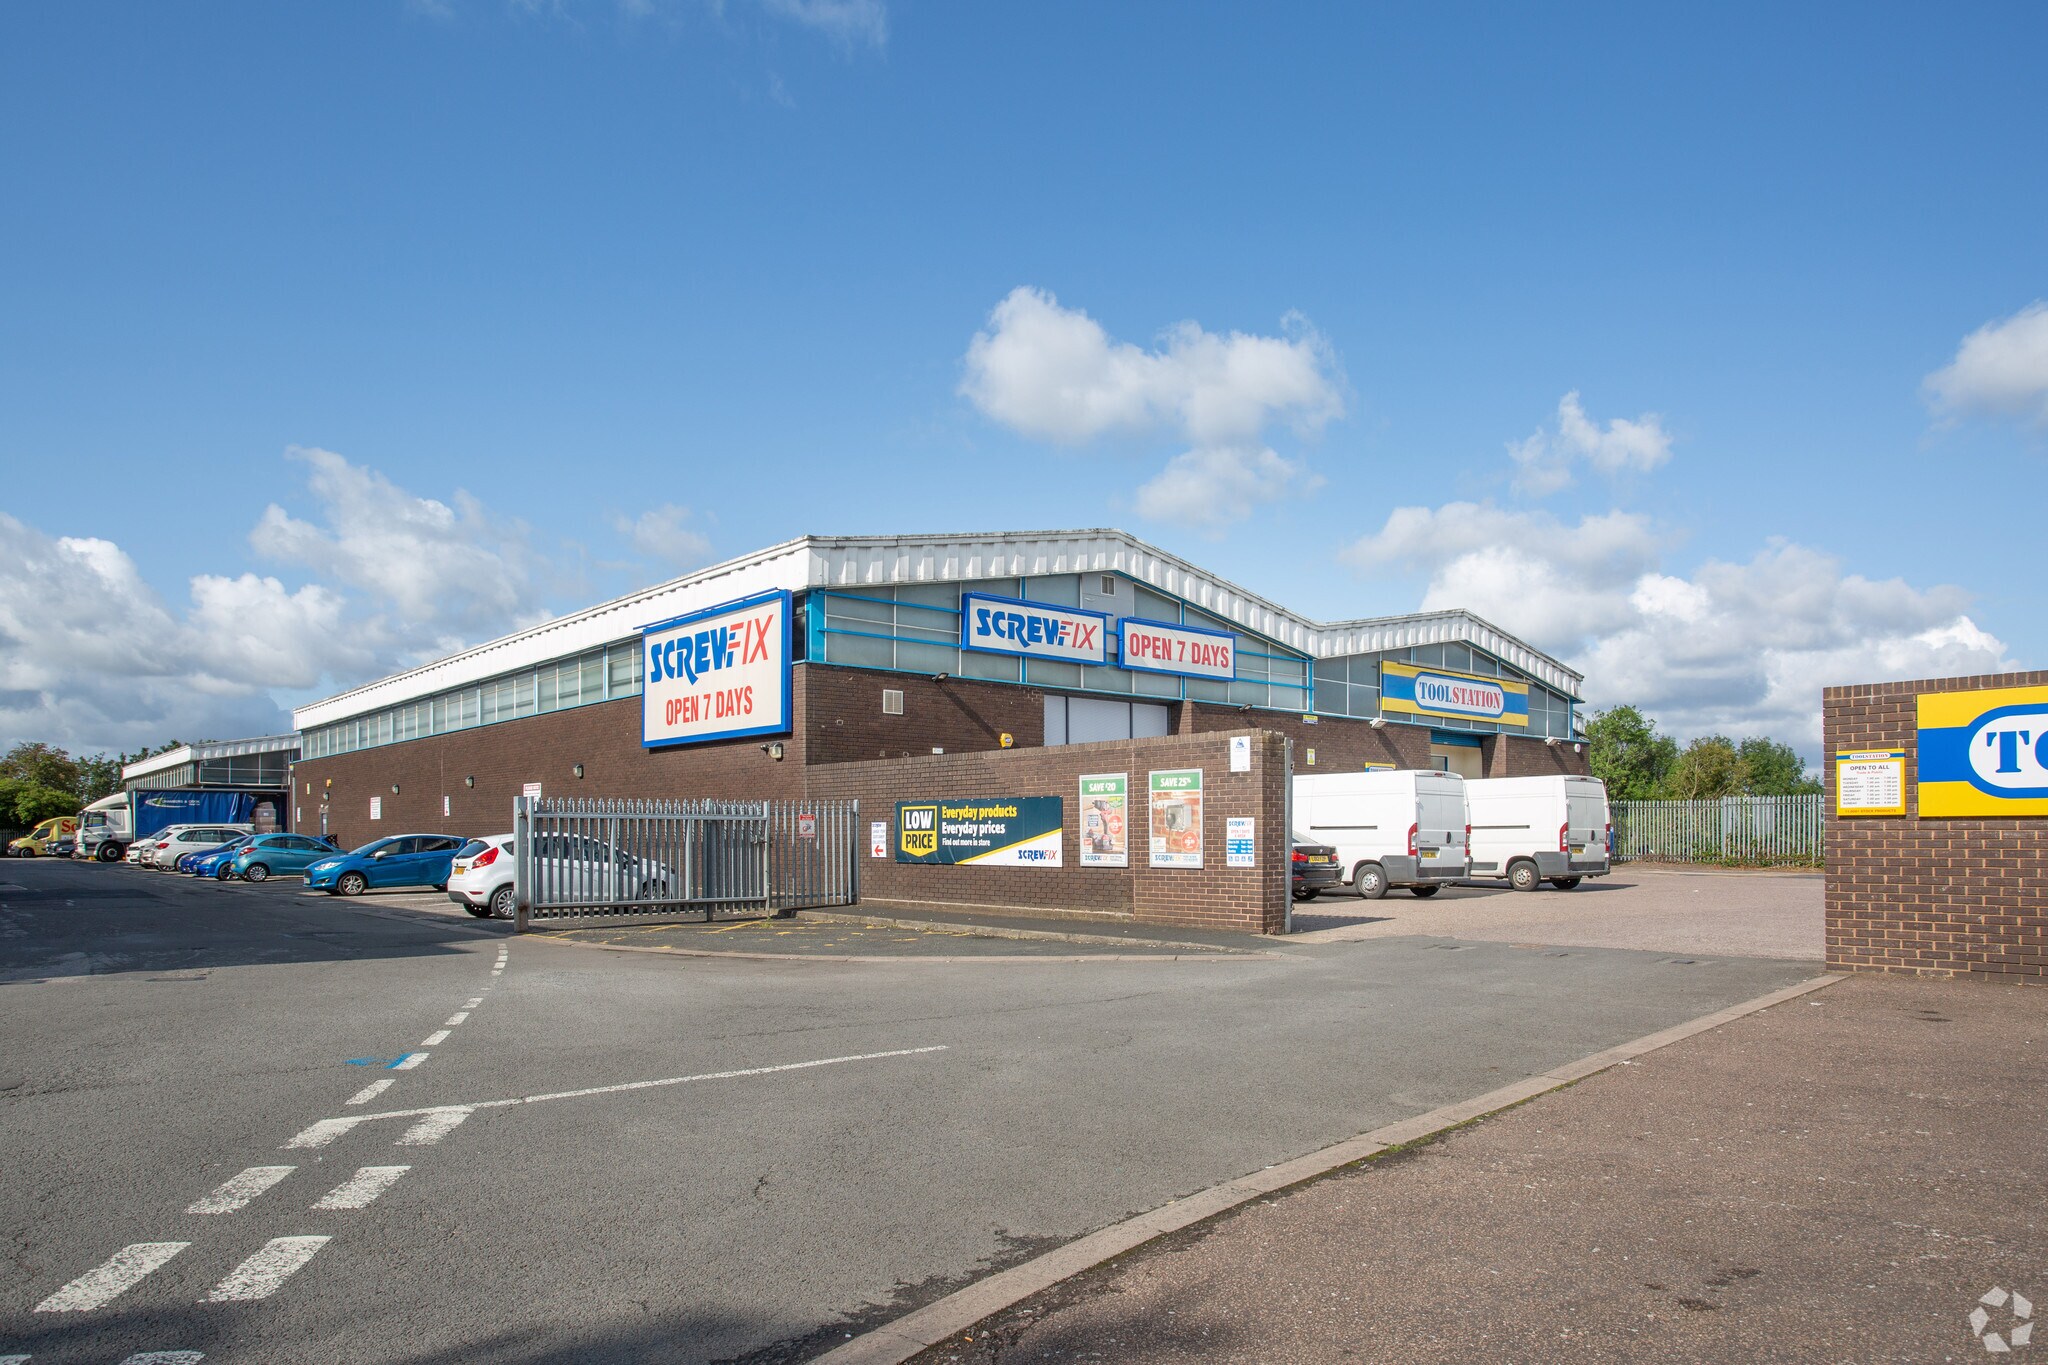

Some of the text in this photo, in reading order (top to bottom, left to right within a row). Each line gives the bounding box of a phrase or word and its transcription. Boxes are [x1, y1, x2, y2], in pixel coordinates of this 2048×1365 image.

[976, 608, 1098, 650] SCREWFIX
[650, 613, 774, 686] SCREWFIX
[1129, 632, 1229, 669] OPEN 7 DAYS
[1418, 681, 1501, 709] TOOLSTATION
[665, 685, 753, 727] OPEN 7 DAYS
[1088, 782, 1105, 792] SAVE
[1160, 777, 1178, 788] SAVE
[905, 810, 933, 830] LOW
[941, 804, 1018, 821] Everyday products
[941, 820, 1006, 837] Everyday prices
[905, 833, 933, 849] PRICE
[942, 838, 952, 846] Find
[1018, 850, 1057, 862] SCREWFIX
